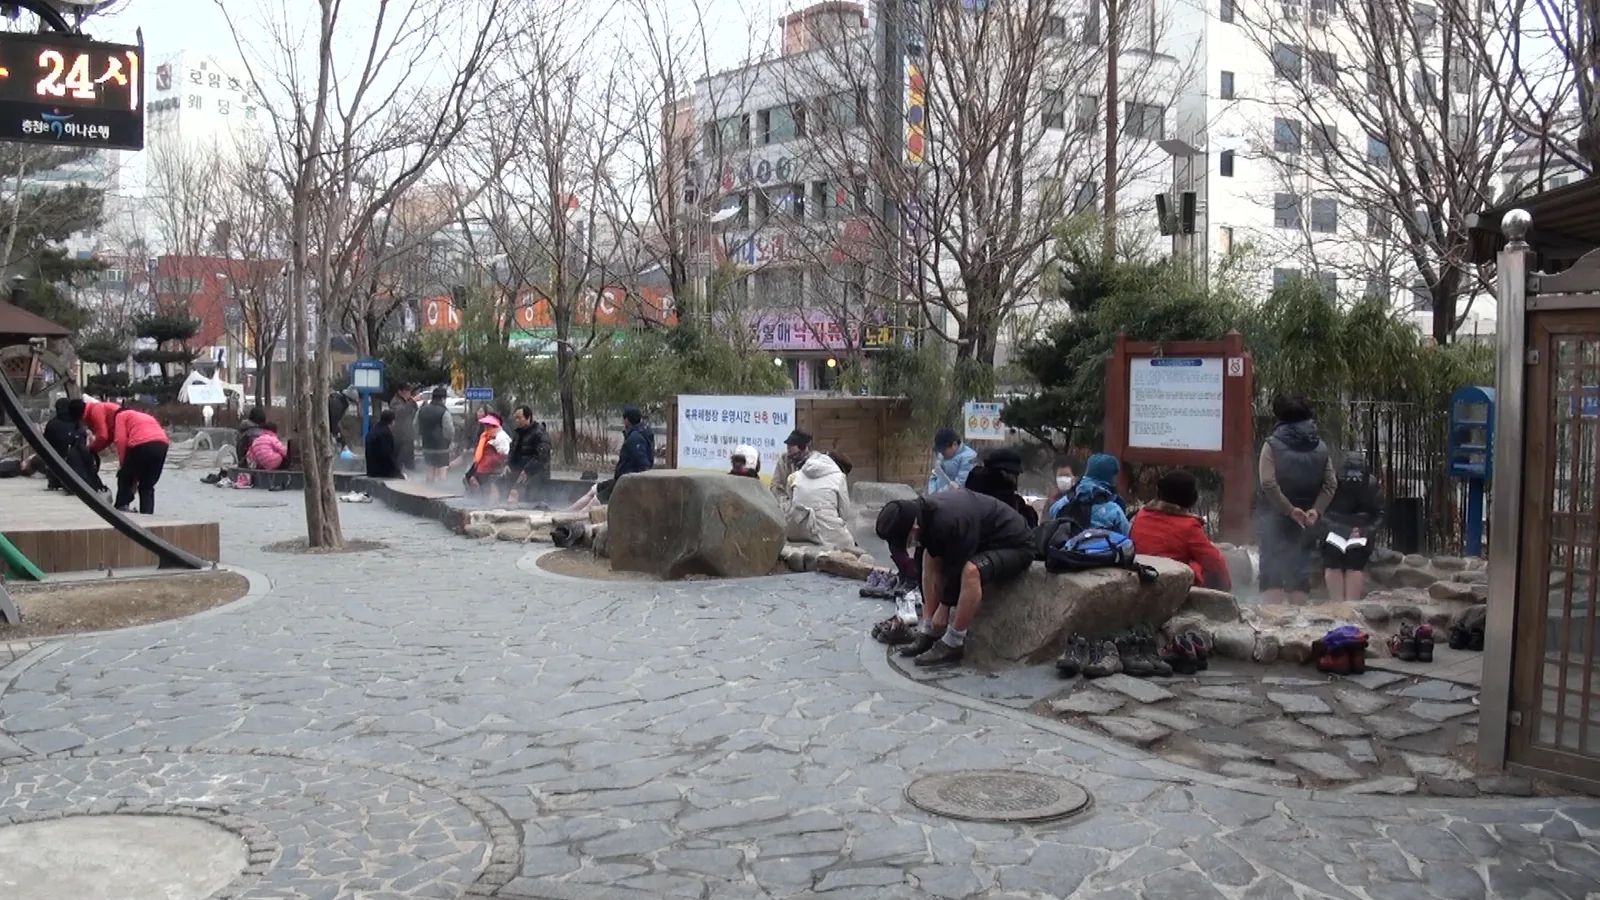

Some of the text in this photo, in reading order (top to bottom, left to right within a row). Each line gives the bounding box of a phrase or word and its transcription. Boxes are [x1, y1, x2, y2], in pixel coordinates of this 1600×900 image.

[36, 49, 139, 111] 24시
[64, 123, 110, 139] 하나은행
[721, 409, 751, 424] 운영시간
[753, 410, 769, 424] 단축
[772, 411, 788, 426] 안내
